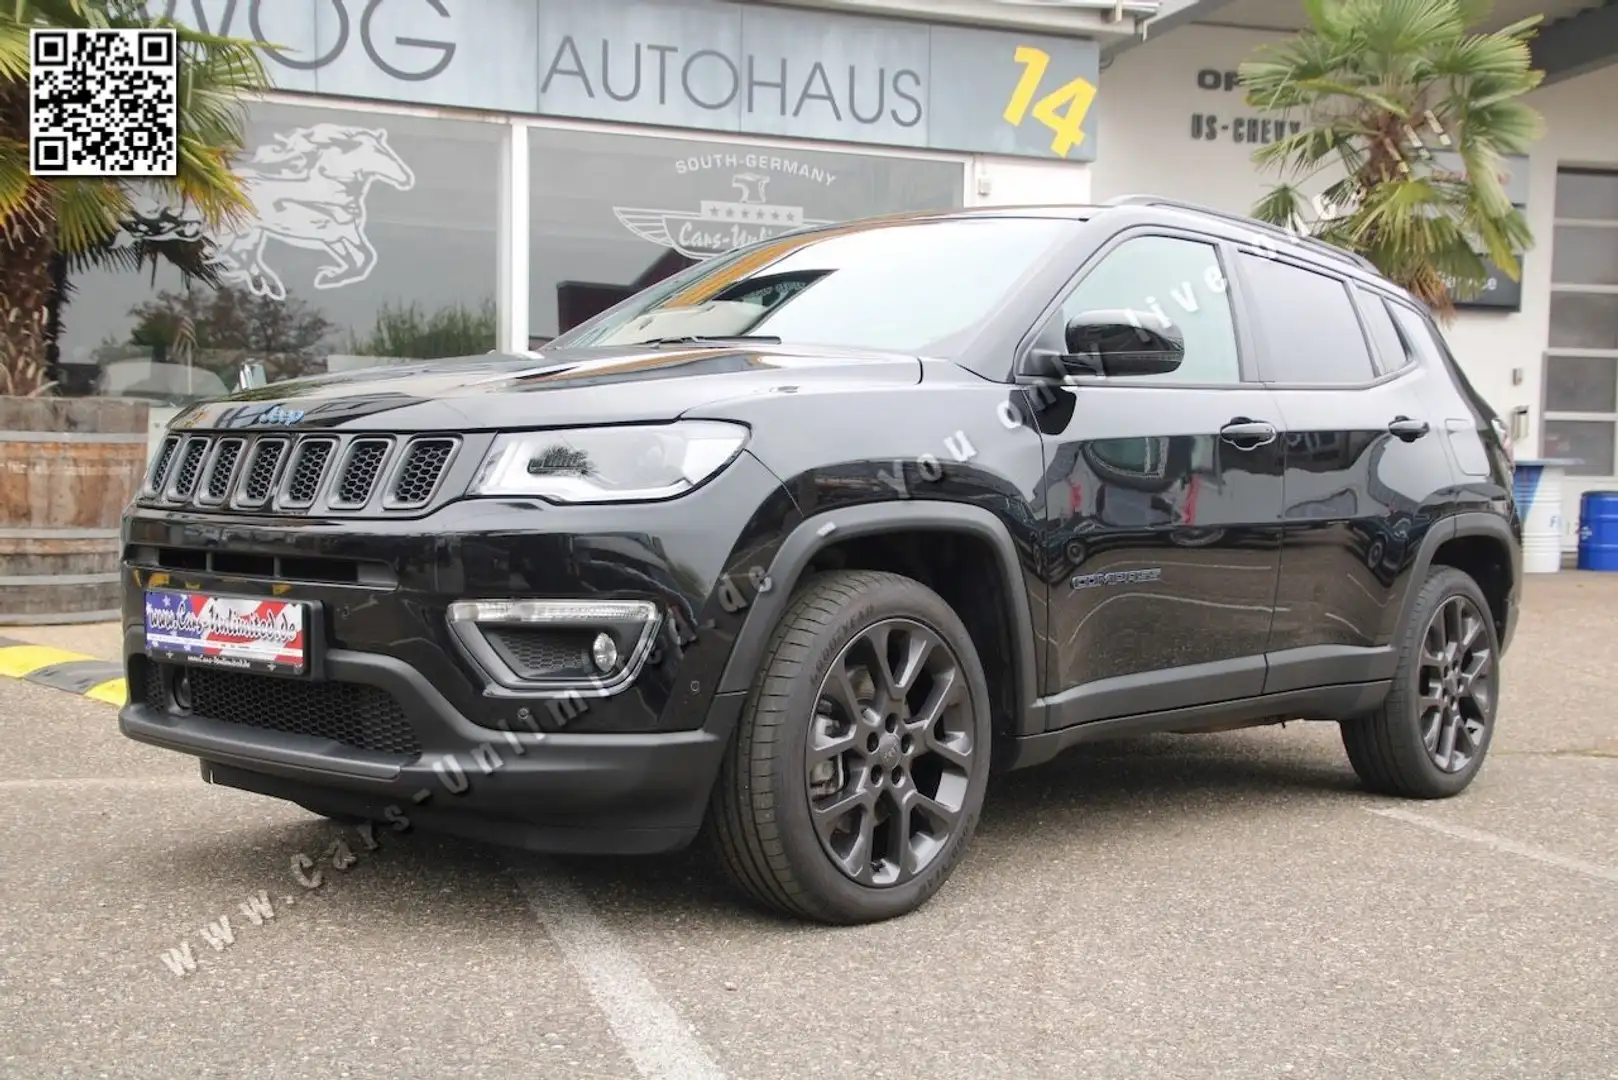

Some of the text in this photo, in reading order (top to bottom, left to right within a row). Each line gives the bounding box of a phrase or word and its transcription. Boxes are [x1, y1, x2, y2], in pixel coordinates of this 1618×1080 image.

[539, 35, 923, 128] AUTOHAUS
[1002, 45, 1097, 159] 14
[675, 153, 837, 187] SOUTH-GERMANY
